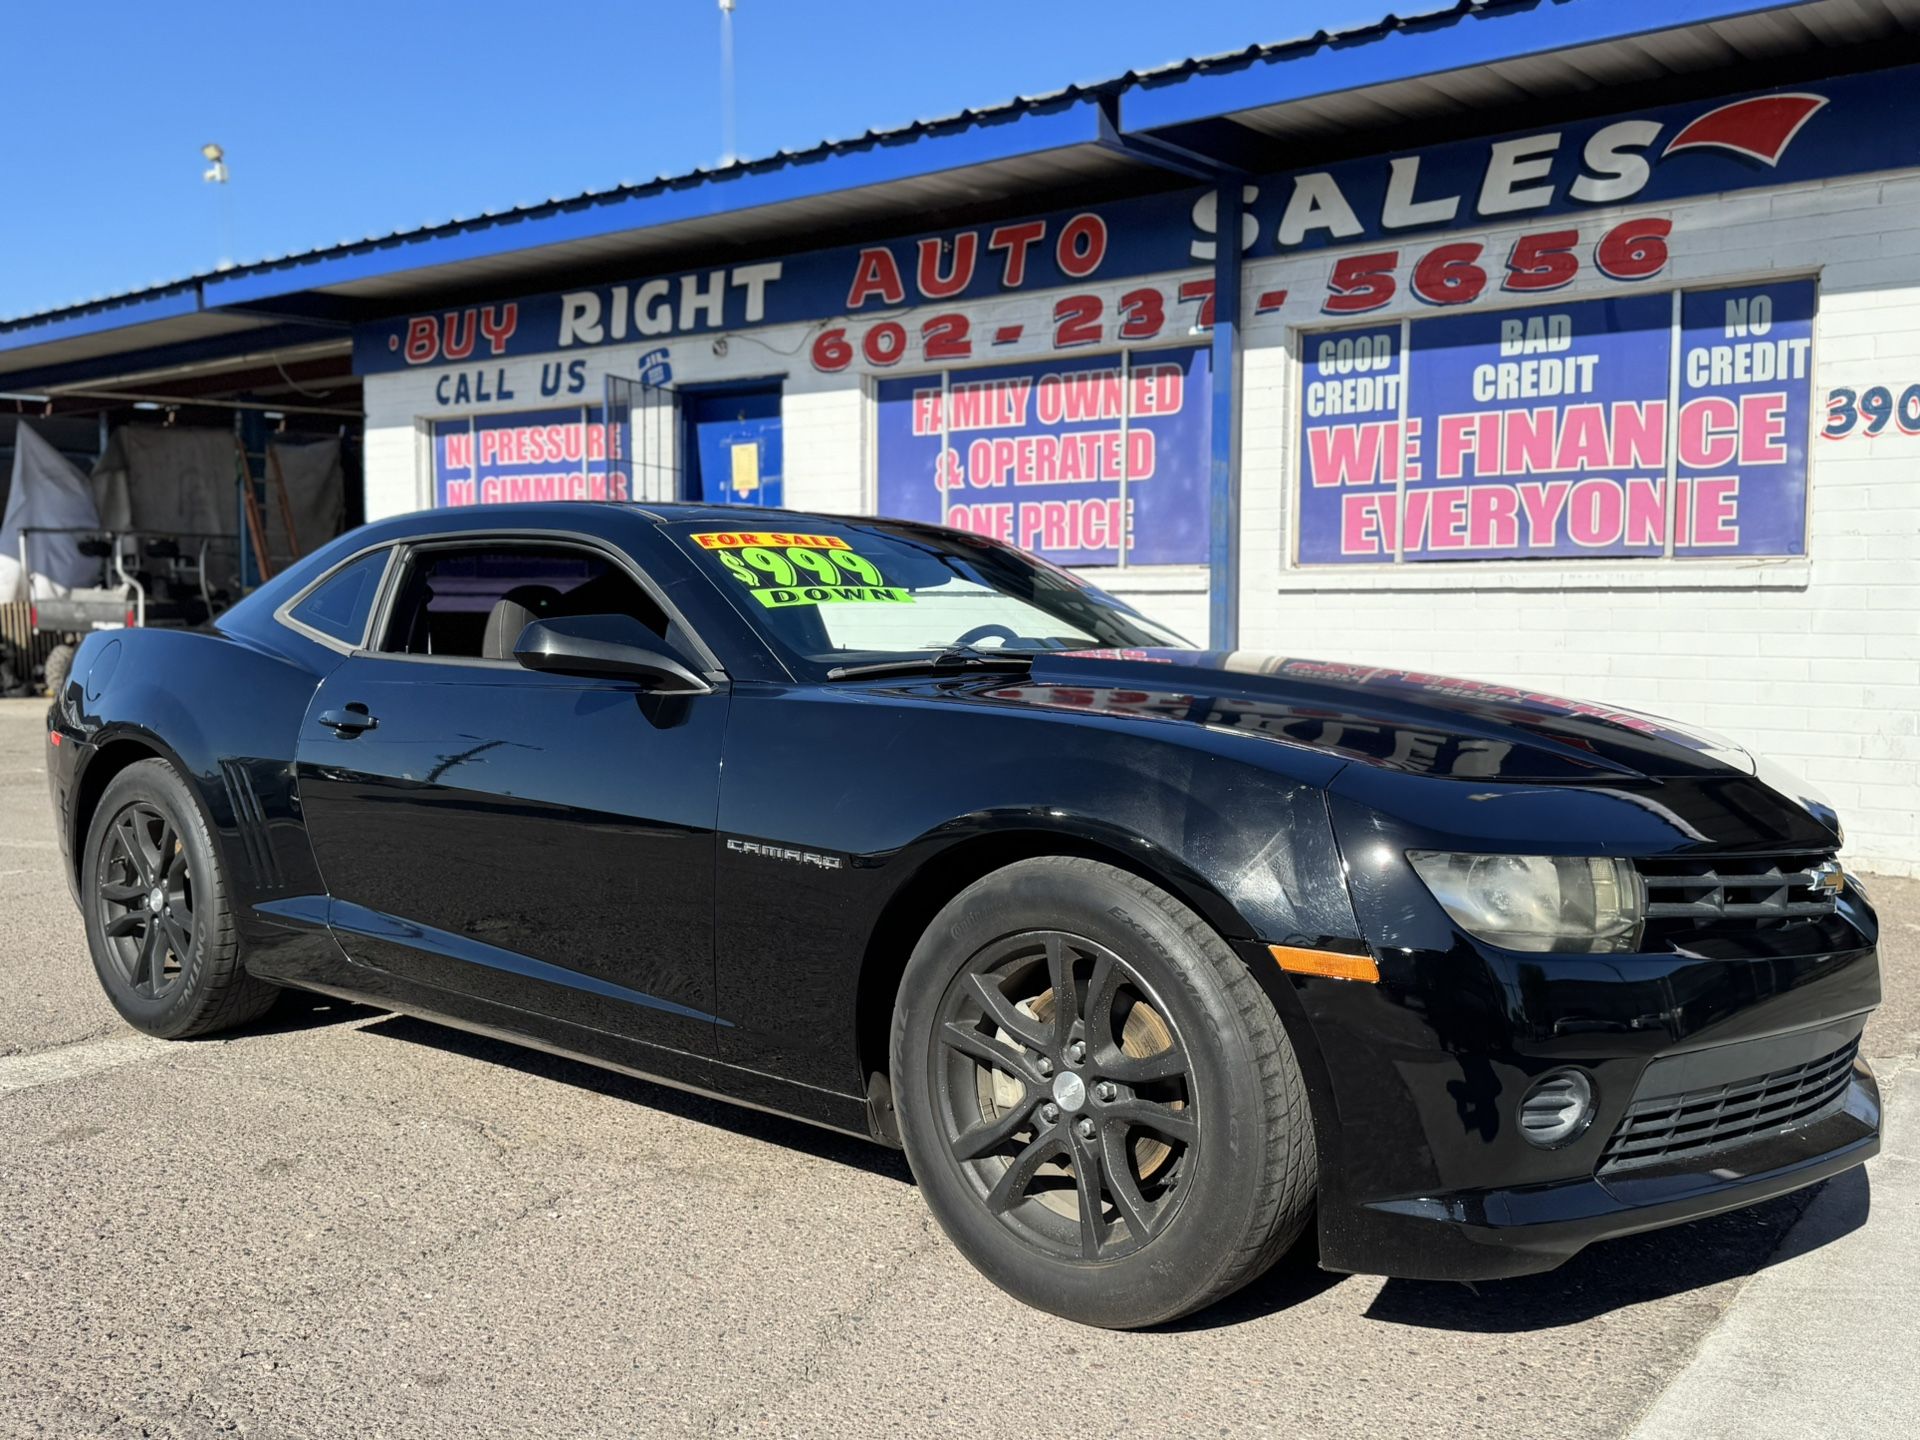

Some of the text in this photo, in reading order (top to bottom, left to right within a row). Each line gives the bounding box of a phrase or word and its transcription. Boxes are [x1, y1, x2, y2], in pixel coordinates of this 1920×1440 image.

[405, 119, 1664, 365] BUY RIGHT AUTO SALES
[1500, 314, 1572, 356] BAD
[1725, 295, 1773, 338] NO
[1317, 334, 1391, 376] GOOD
[1687, 337, 1811, 388] CREDIT
[436, 359, 587, 405] CALL US
[912, 362, 1184, 436] FAMILY OWNED
[1307, 374, 1400, 417] CREDIT
[1473, 355, 1599, 401] CREDIT
[480, 422, 622, 466] PRESSURE
[934, 428, 1156, 491] & OPERATED
[1306, 391, 1789, 488] WE FINANCE
[481, 471, 629, 504] GIMMICKS
[949, 498, 1135, 550] ONE PRICE
[1341, 475, 1740, 555] EVERYONE
[697, 533, 844, 548] FOR SALE
[718, 548, 884, 587] $999
[769, 587, 901, 604] DOWN
[727, 839, 842, 869] CAMARO
